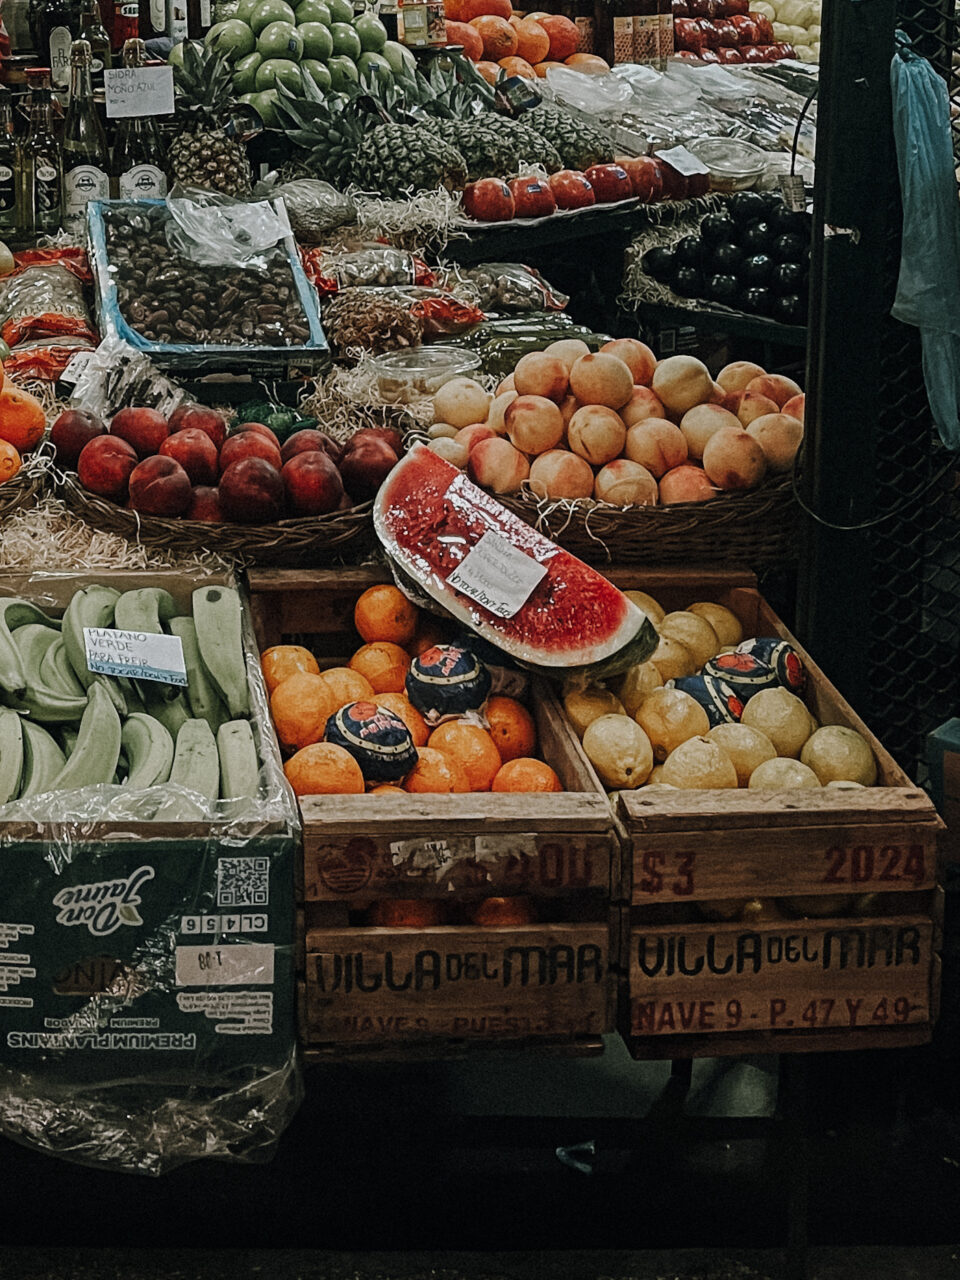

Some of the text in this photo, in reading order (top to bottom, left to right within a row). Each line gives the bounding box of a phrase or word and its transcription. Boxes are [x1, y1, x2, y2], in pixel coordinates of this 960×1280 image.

[107, 70, 138, 80] SIDRA
[88, 628, 147, 643] PLATANO
[90, 638, 134, 653] VERDE
[88, 649, 115, 663] PARA
[822, 844, 926, 884] 2024
[51, 866, 155, 907] Jaime
[62, 901, 121, 933] Don
[185, 915, 265, 932] CL 4 5 6
[637, 925, 922, 979] VILLA DEL MAR
[313, 943, 603, 994] VILLA DEL MAR
[109, 1016, 160, 1029] PREMIUM
[632, 999, 717, 1031] NAVE
[725, 997, 743, 1030] 9
[802, 997, 837, 1027] 47
[871, 996, 911, 1025] 49
[6, 1030, 196, 1051] PREMIUM PLANTAINS
